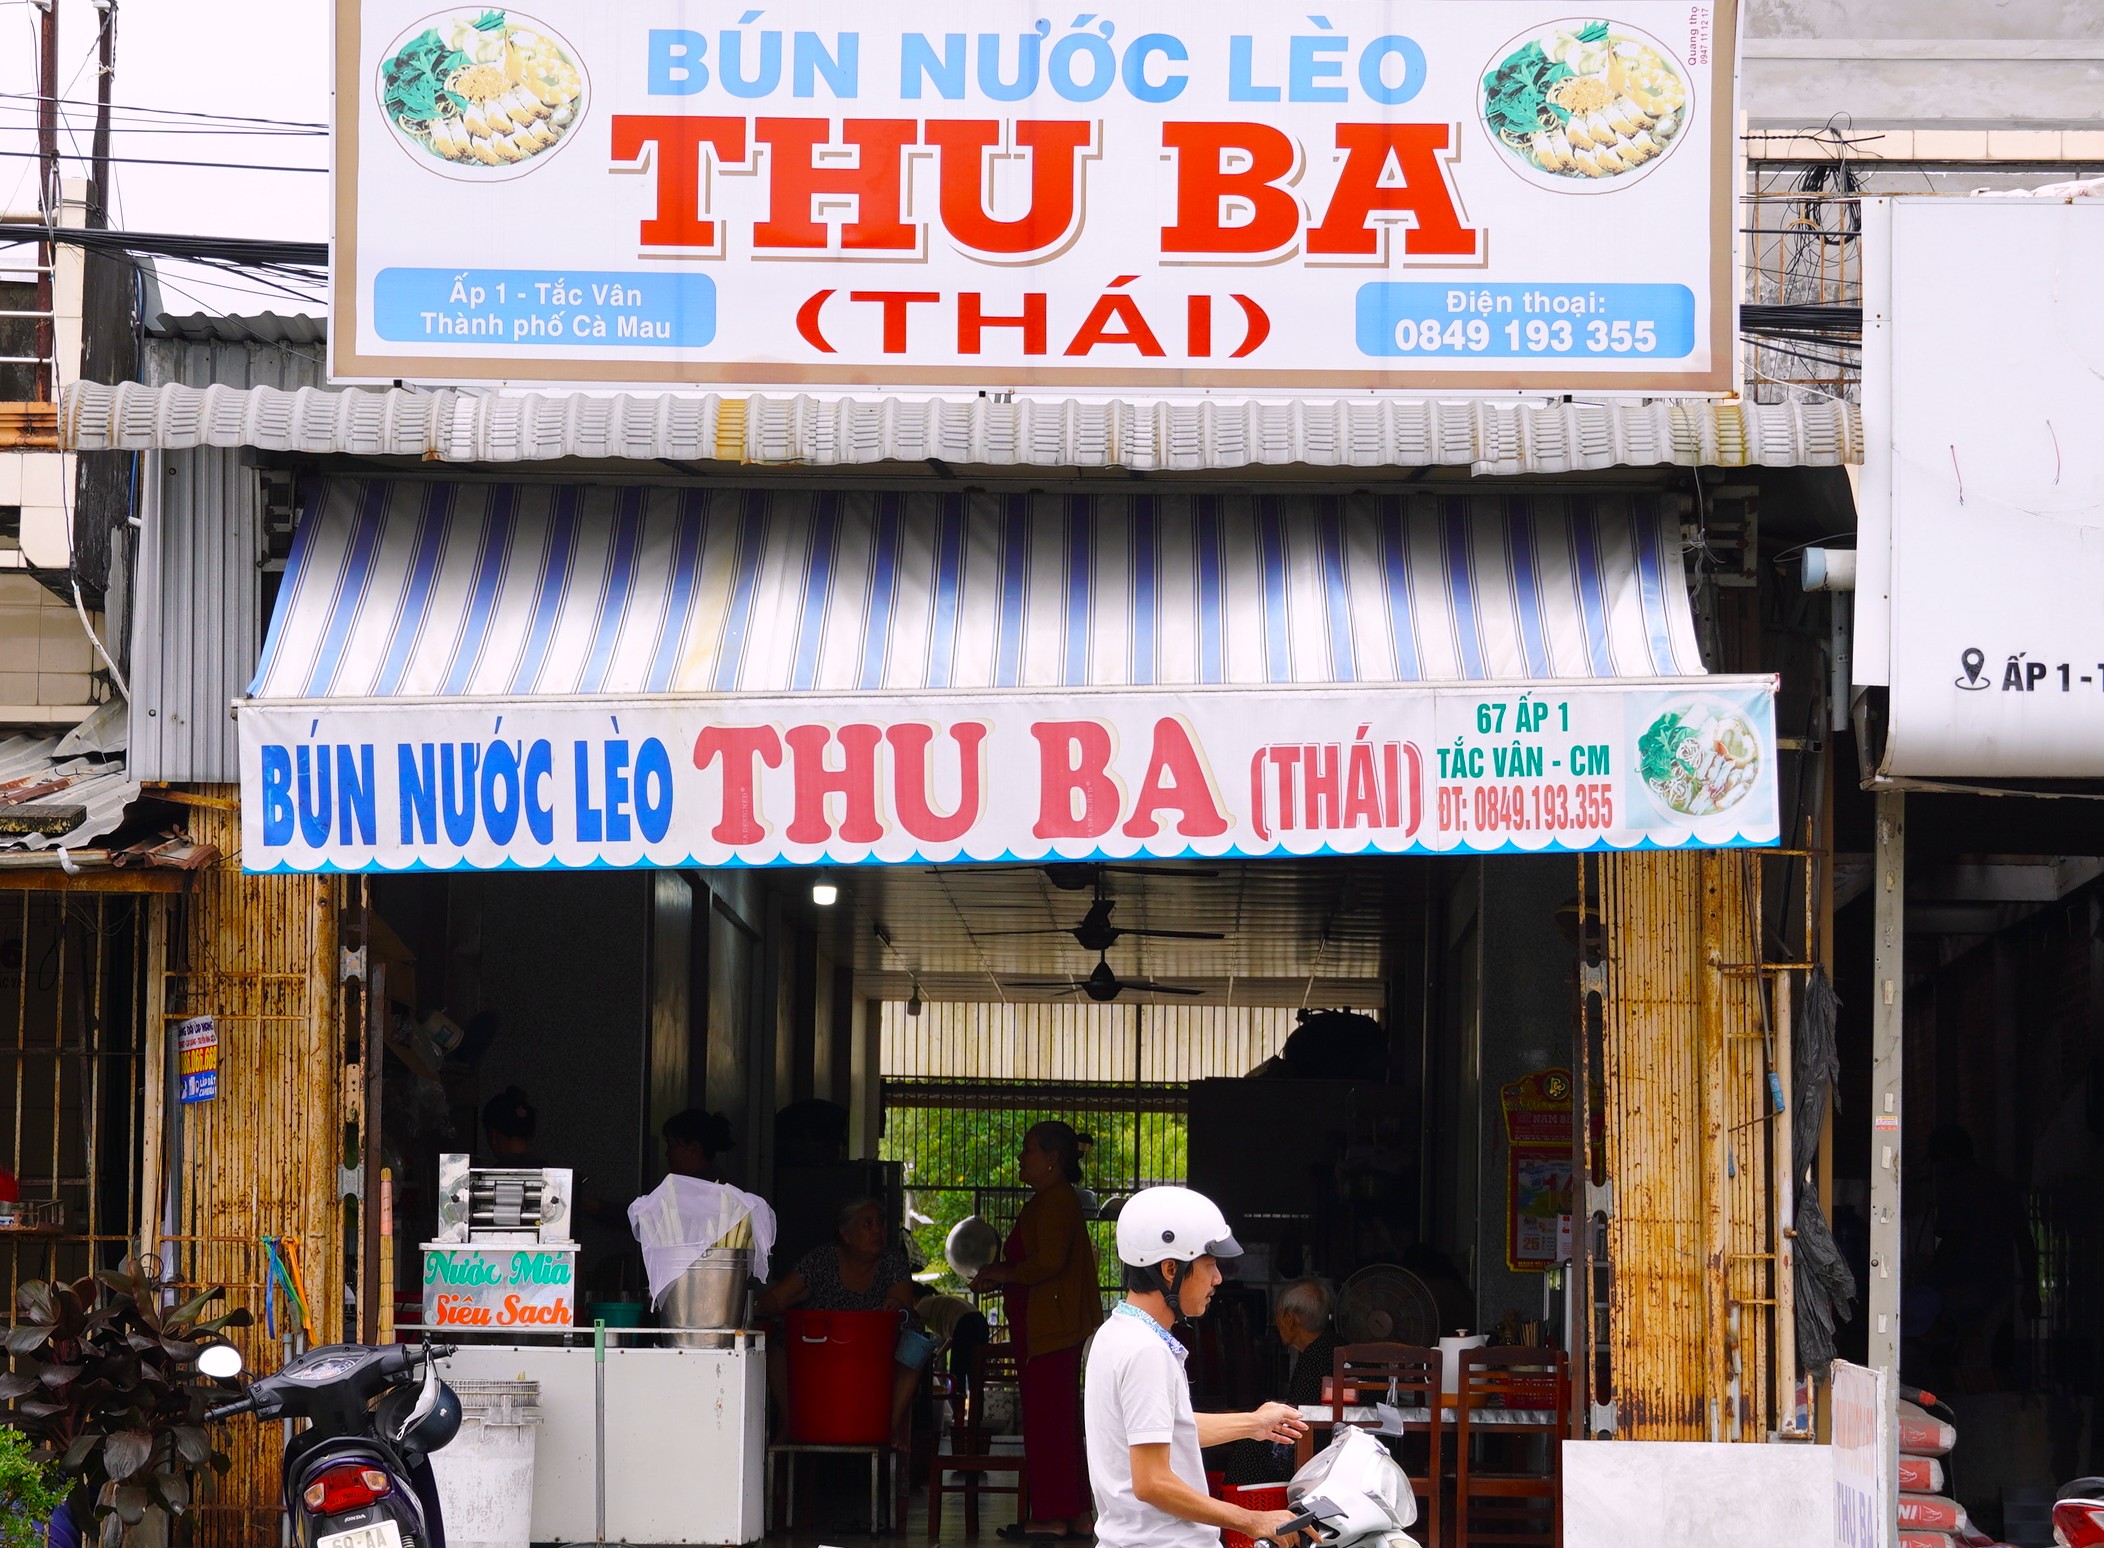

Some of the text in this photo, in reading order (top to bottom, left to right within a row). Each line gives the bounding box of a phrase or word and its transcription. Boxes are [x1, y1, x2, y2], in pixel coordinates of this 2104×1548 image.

[1688, 29, 1699, 66] Quang
[1700, 8, 1709, 65] 0947 11 12 17
[648, 10, 1427, 105] BÚN NƯỚC LÈO
[610, 115, 1482, 262] THU BA
[449, 276, 486, 307] Ấp
[496, 284, 505, 304] 1
[534, 279, 583, 306] Tắc
[592, 284, 641, 306] Vân
[1446, 290, 1605, 318] Điện thoại:
[420, 311, 670, 341] Thành phố Cà Mau
[796, 275, 1270, 358] (THÁI)
[1395, 321, 1657, 352] 0849 193 355
[2002, 652, 2047, 692] ẤP
[2057, 663, 2070, 692] 1
[1475, 691, 1569, 734] 67 ẤP 1
[1436, 735, 1611, 780] TẮC VÂN - CM
[261, 716, 674, 849] BÚN NƯỚC LÈO
[693, 717, 1424, 846] THU BA (THÁI)
[1437, 784, 1613, 833] ĐT: 0849.193.355
[424, 1251, 502, 1287] Nước
[425, 1294, 492, 1327] Siêu
[344, 1513, 367, 1523] HONDA
